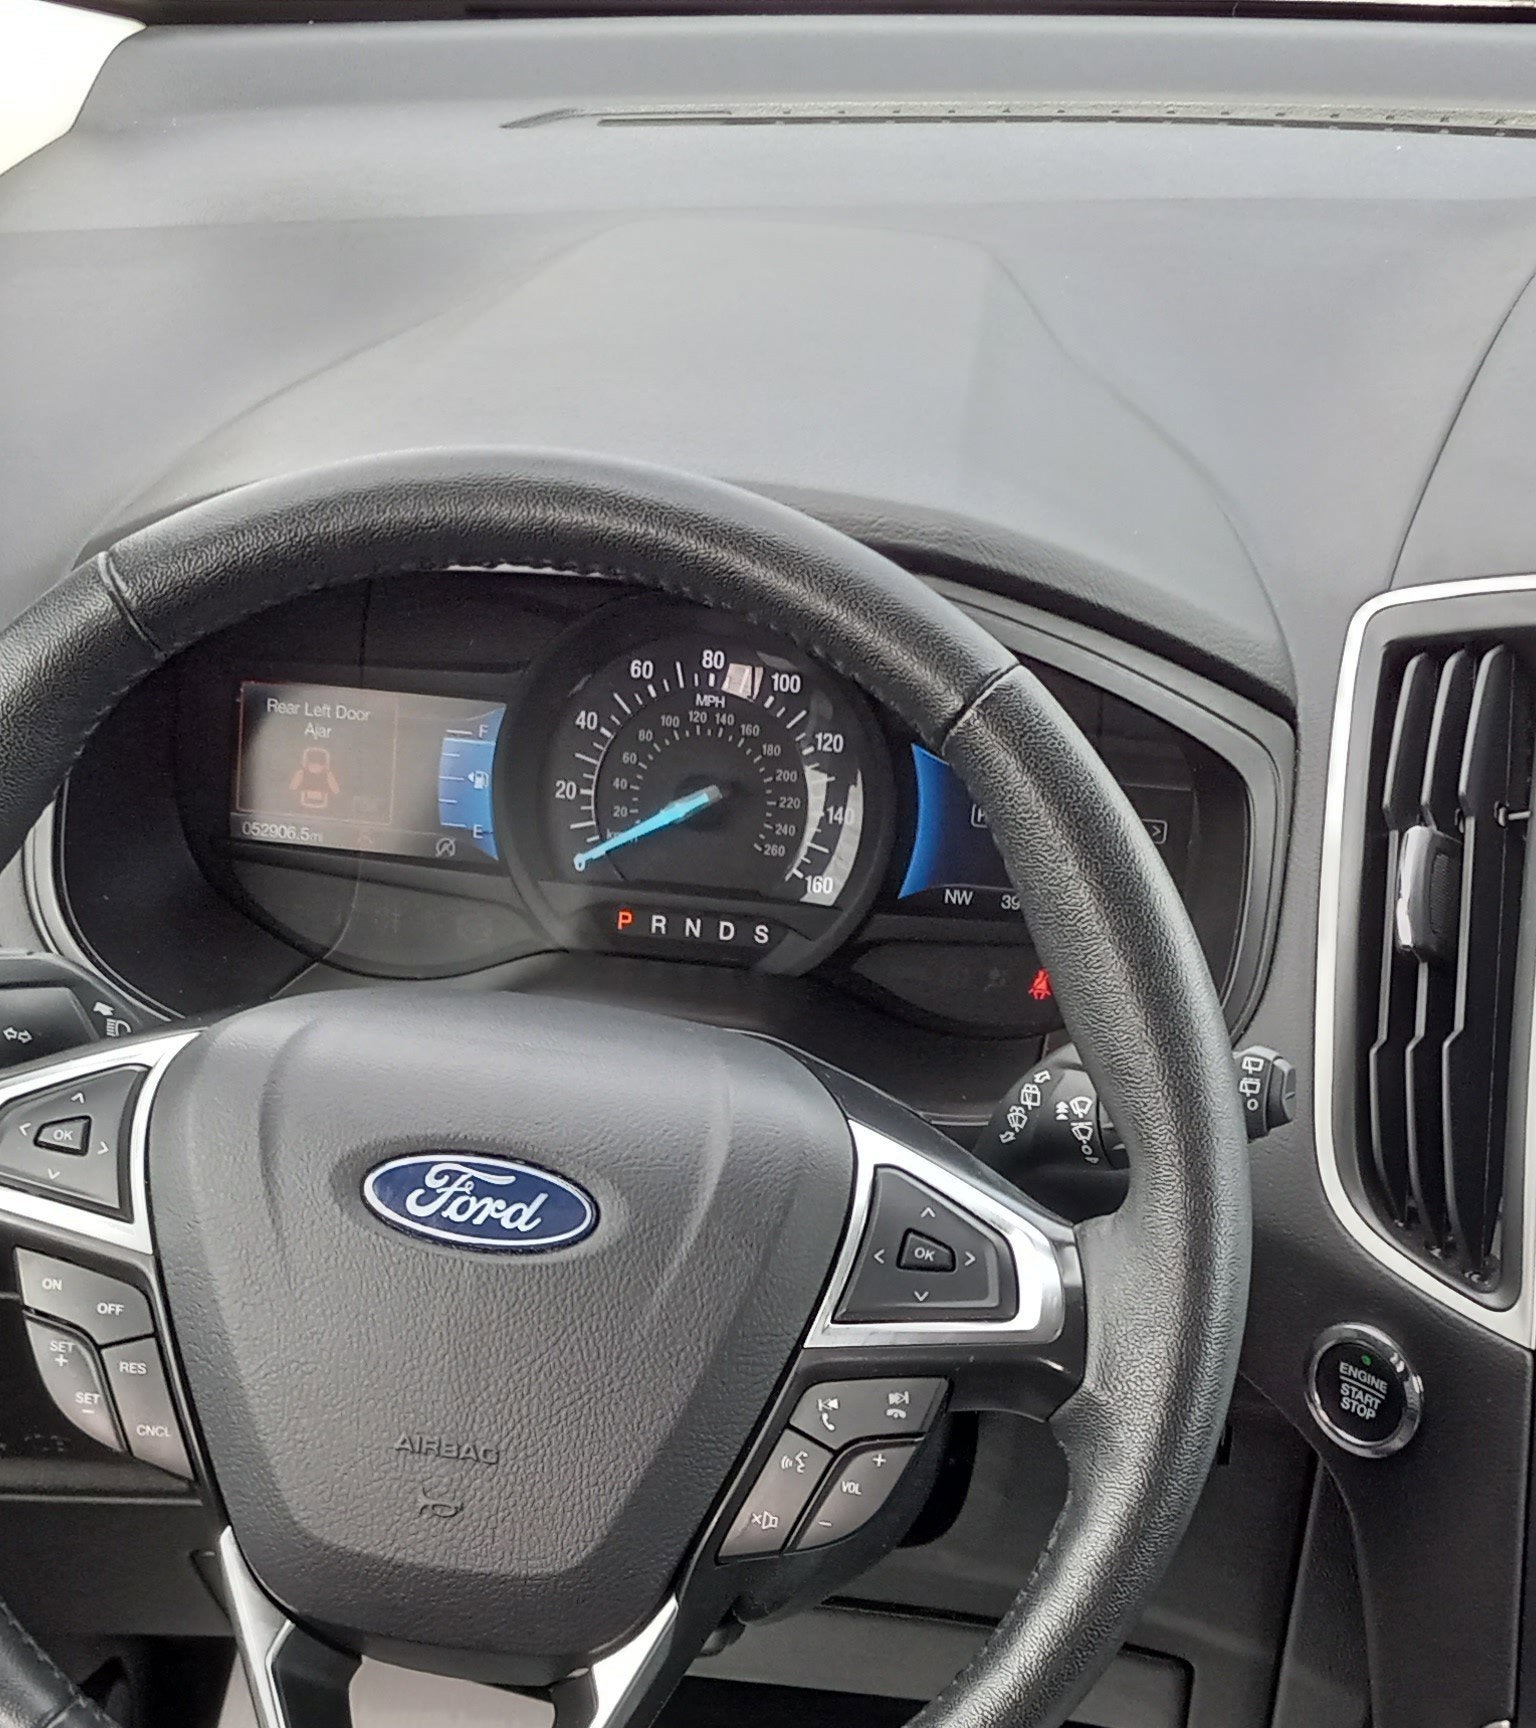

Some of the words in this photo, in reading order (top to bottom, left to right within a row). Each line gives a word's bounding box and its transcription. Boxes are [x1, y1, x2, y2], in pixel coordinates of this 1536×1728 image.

[702, 650, 725, 669] 80
[630, 660, 654, 680] 60
[771, 674, 801, 693] 100
[695, 694, 726, 708] MPH
[267, 697, 300, 716] Rear
[304, 701, 331, 719] Left
[335, 705, 371, 722] Door
[575, 711, 598, 731] 40
[660, 715, 680, 728] 100
[688, 711, 707, 724] 120
[715, 713, 735, 726] 140
[304, 722, 332, 740] Ajar
[478, 725, 489, 738] F
[638, 730, 653, 742] 80
[740, 724, 760, 737] 160
[762, 743, 781, 756] 180
[815, 733, 844, 752] 120
[622, 753, 637, 765] 60
[775, 769, 797, 782] 200
[555, 781, 577, 800] 20
[613, 778, 628, 790] 40
[779, 797, 800, 810] 220
[614, 806, 628, 818] 20
[827, 806, 853, 825] 140
[473, 825, 484, 839] E
[775, 824, 796, 837] 240
[764, 844, 785, 857] 260
[805, 875, 833, 894] 160
[944, 889, 973, 906] NW
[617, 911, 633, 930] P
[651, 915, 667, 934] R
[685, 918, 702, 937] N
[719, 921, 735, 940] D
[753, 925, 769, 943] S
[52, 1129, 74, 1142] OK
[406, 1162, 550, 1233] Ford
[914, 1247, 937, 1262] OK
[42, 1278, 63, 1291] ON
[97, 1303, 124, 1316] OFF
[49, 1341, 76, 1353] SET
[119, 1362, 147, 1375] RES
[1339, 1361, 1389, 1393] ENGINE
[75, 1393, 101, 1404] SET
[1340, 1383, 1382, 1410] START
[1340, 1396, 1377, 1421] STOP
[136, 1424, 170, 1438] CNCL
[395, 1436, 501, 1467] AIRBAG
[840, 1480, 862, 1497] VOL
